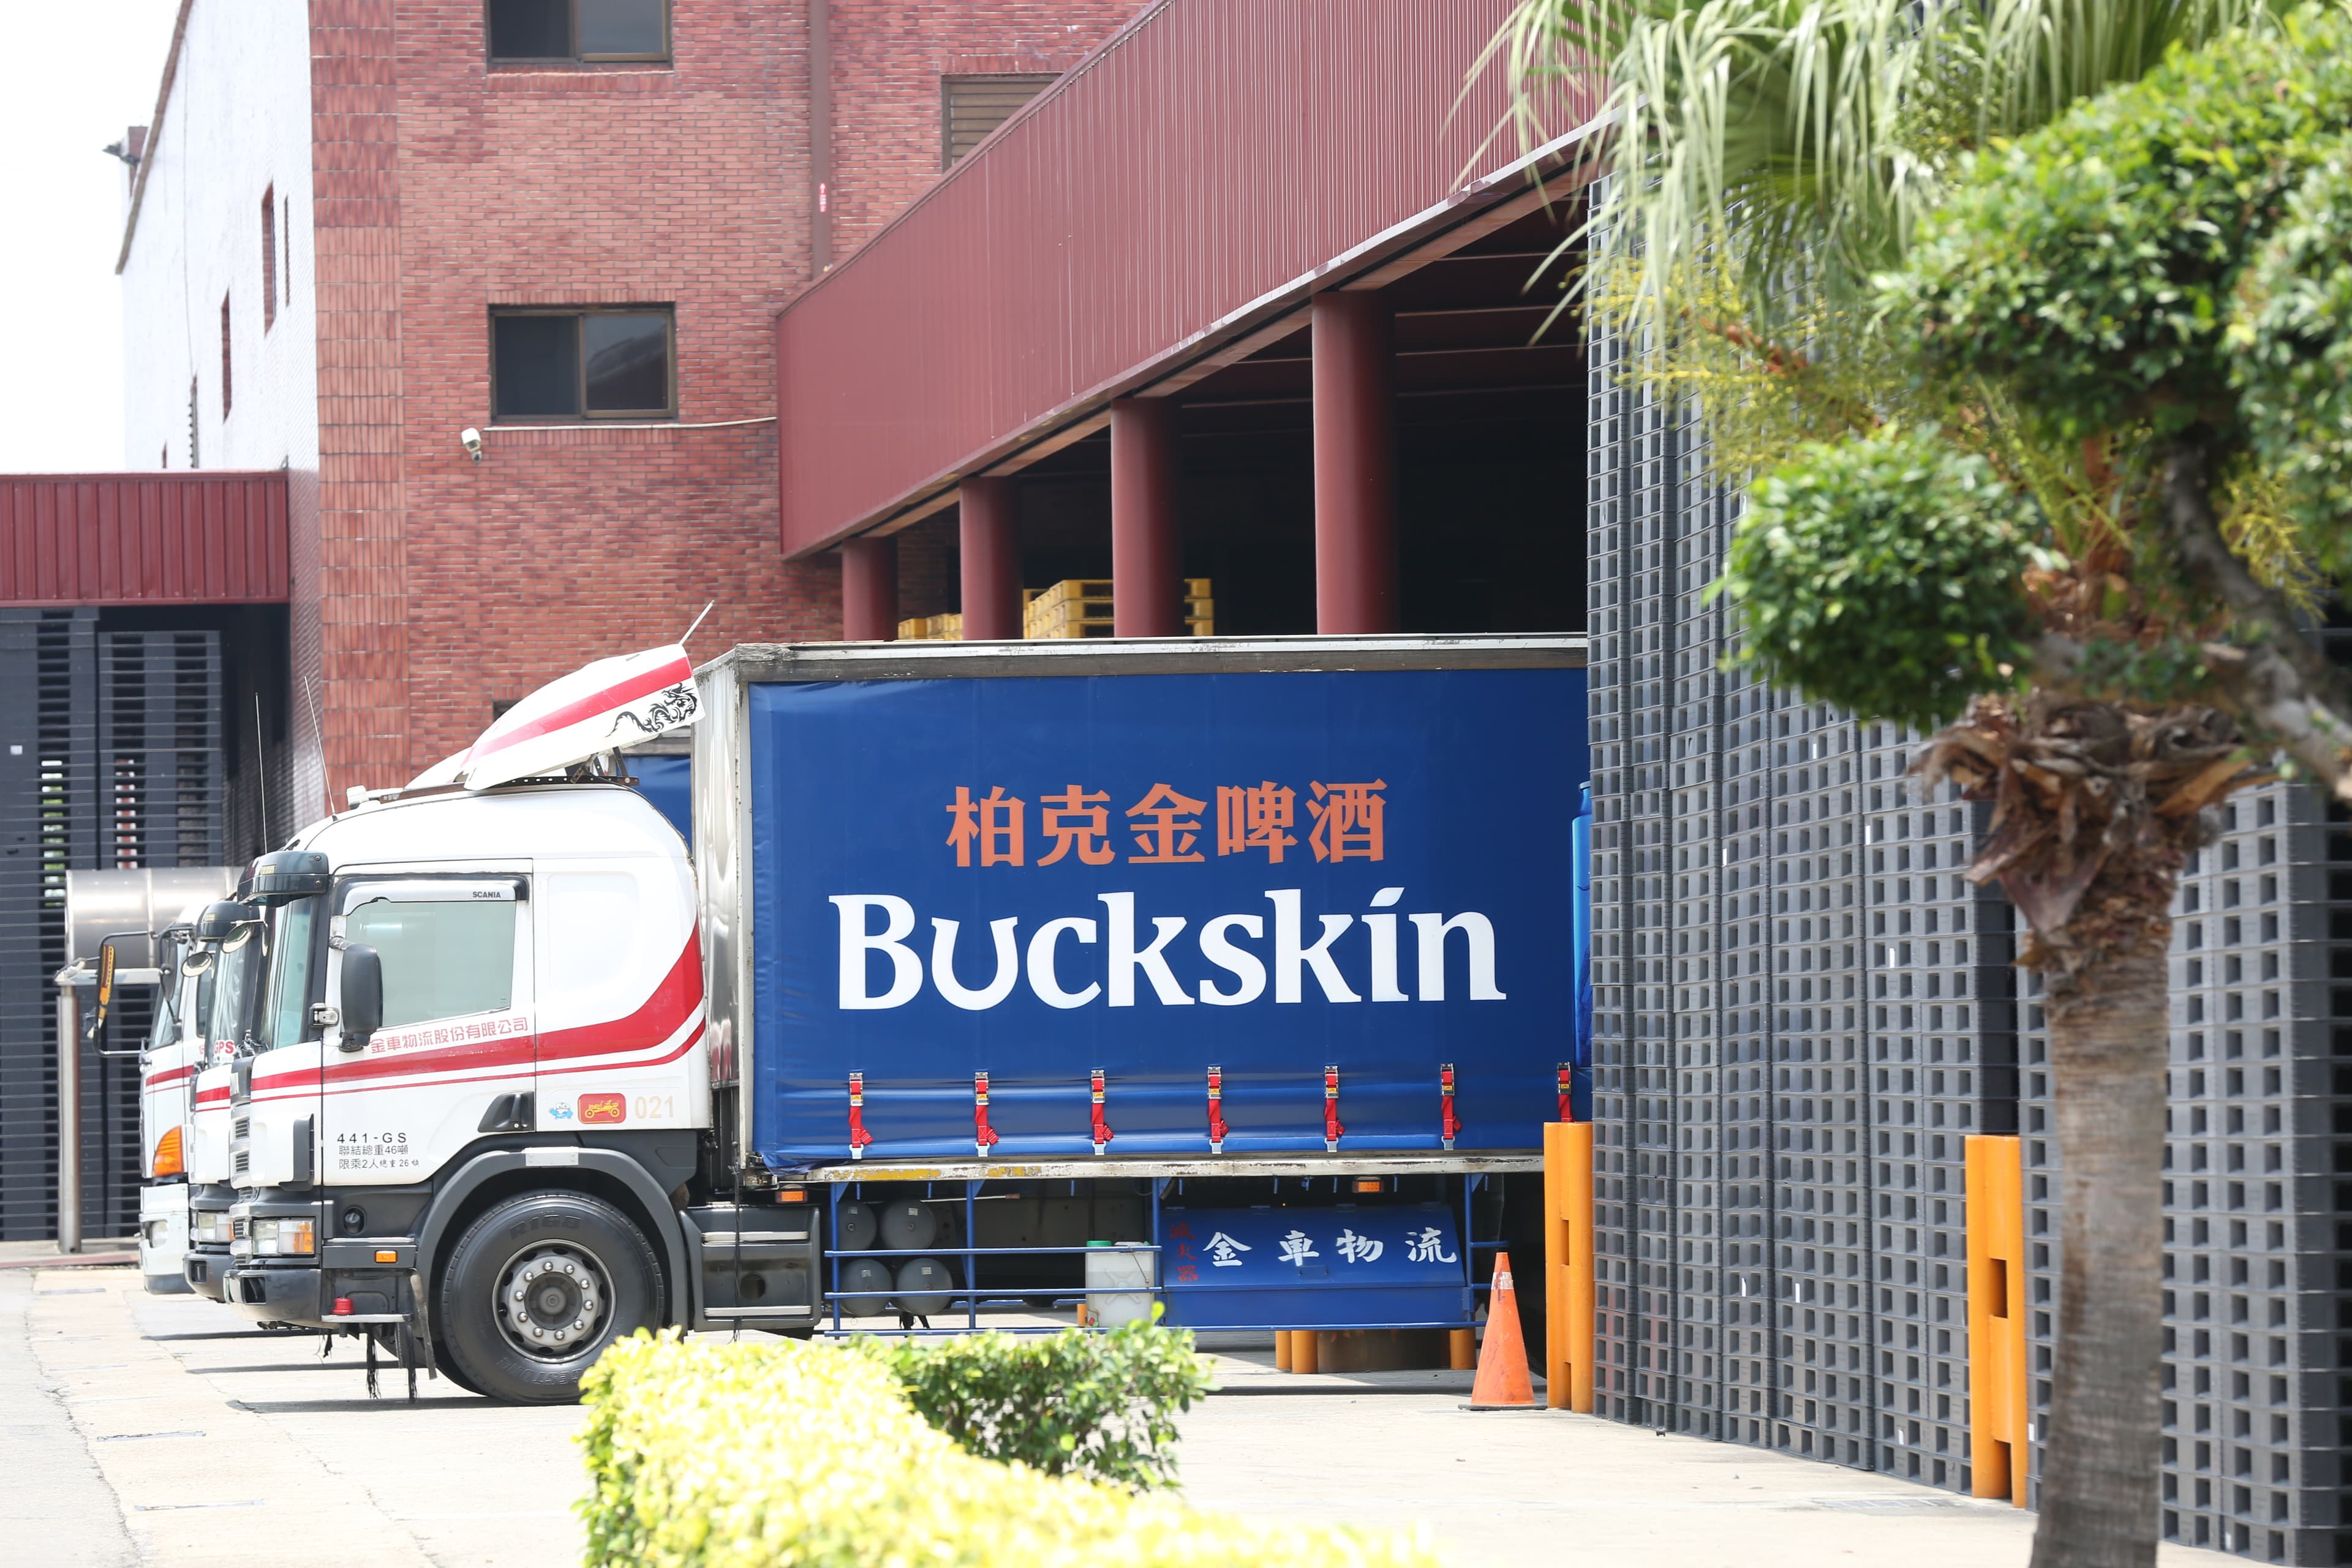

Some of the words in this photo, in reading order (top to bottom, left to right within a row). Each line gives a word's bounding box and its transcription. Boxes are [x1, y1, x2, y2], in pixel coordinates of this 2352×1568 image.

[946, 779, 1387, 867] 柏克金啤酒
[214, 1041, 235, 1054] GPS
[371, 1017, 529, 1054] 金車物流股份有限公司
[635, 1095, 674, 1119] 021
[337, 1133, 407, 1144] 441-GS
[1203, 1227, 1457, 1267] 金車物流
